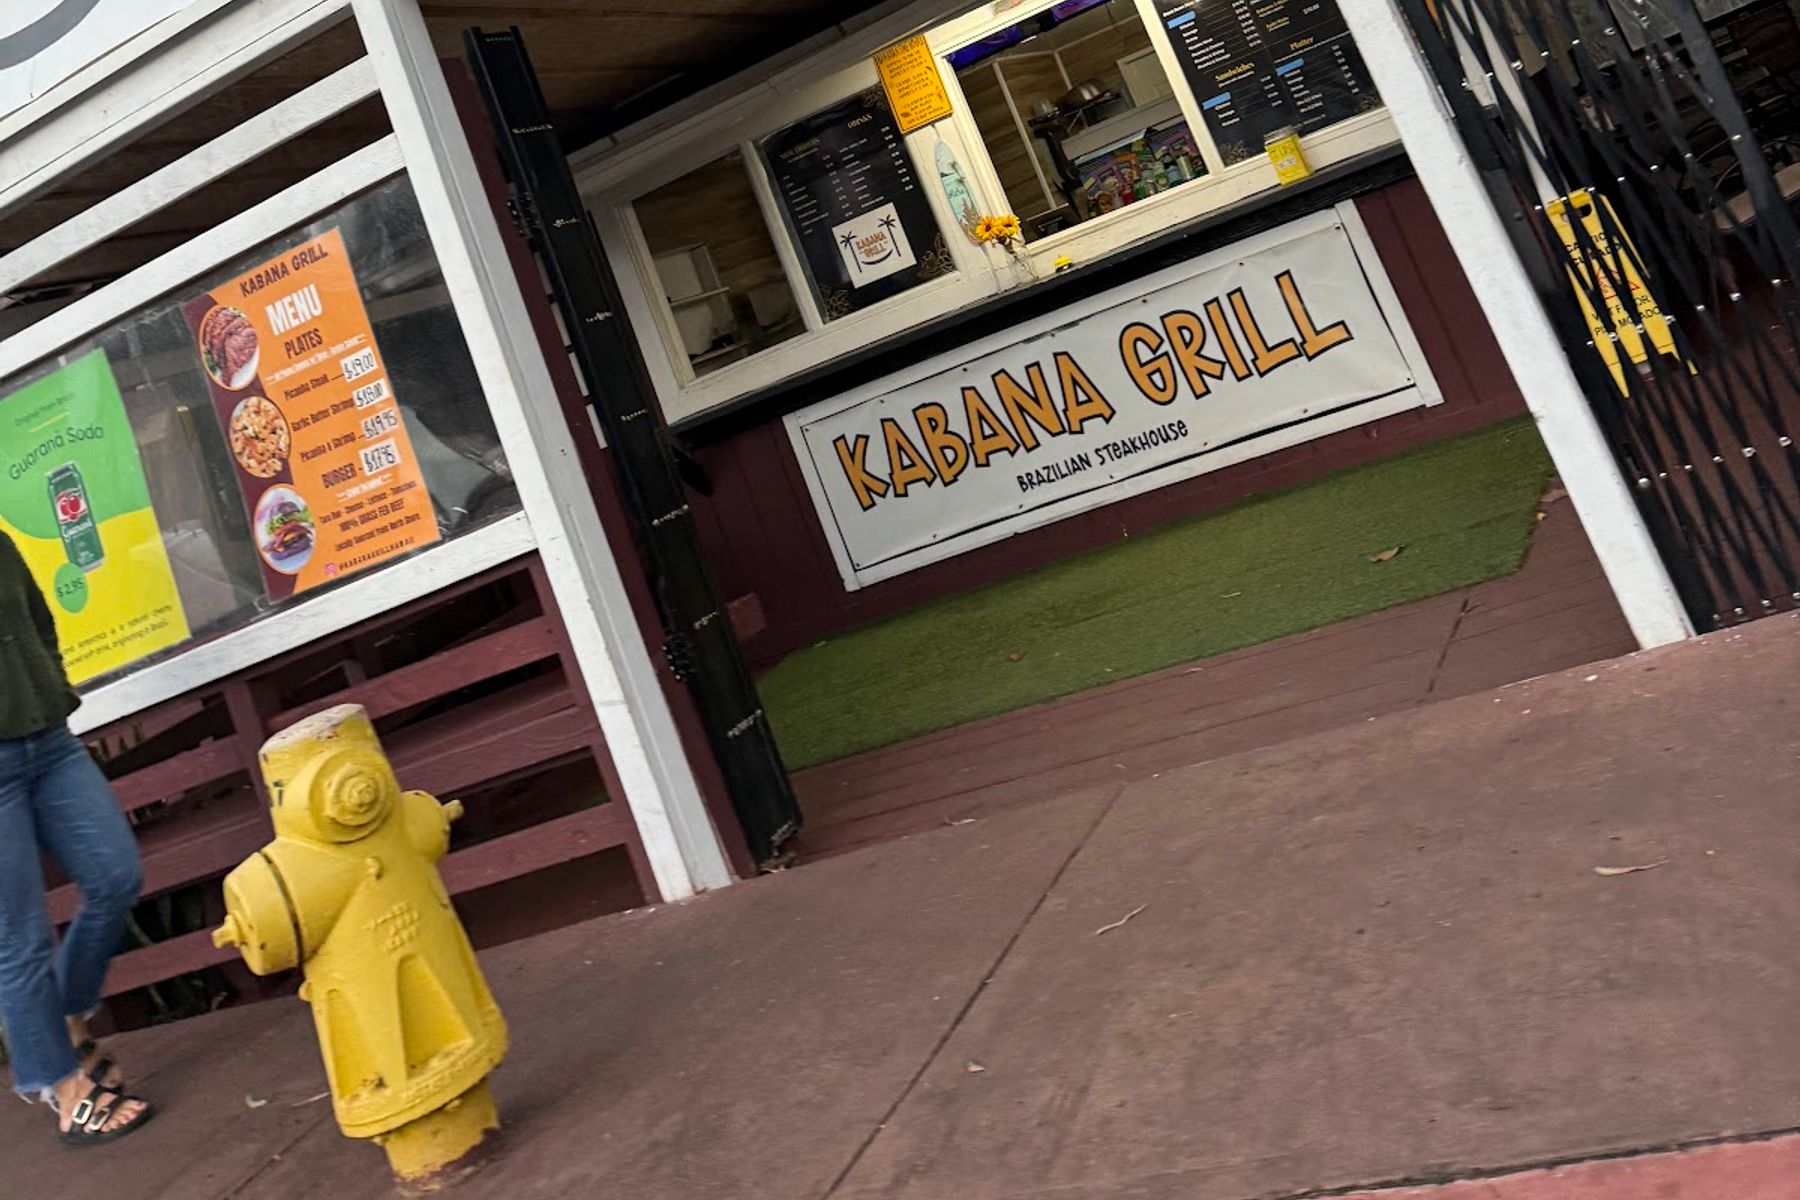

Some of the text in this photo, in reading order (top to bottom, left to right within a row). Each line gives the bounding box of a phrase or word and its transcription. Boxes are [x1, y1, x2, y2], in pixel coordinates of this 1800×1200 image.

[239, 243, 328, 297] KABANA GRILL
[264, 283, 323, 336] MENU
[284, 328, 323, 360] PLATES
[833, 270, 1354, 511] KABANA GRILL
[66, 423, 105, 448] Soda
[321, 462, 357, 489] BURGER
[1016, 452, 1092, 493] BRAZILIAN
